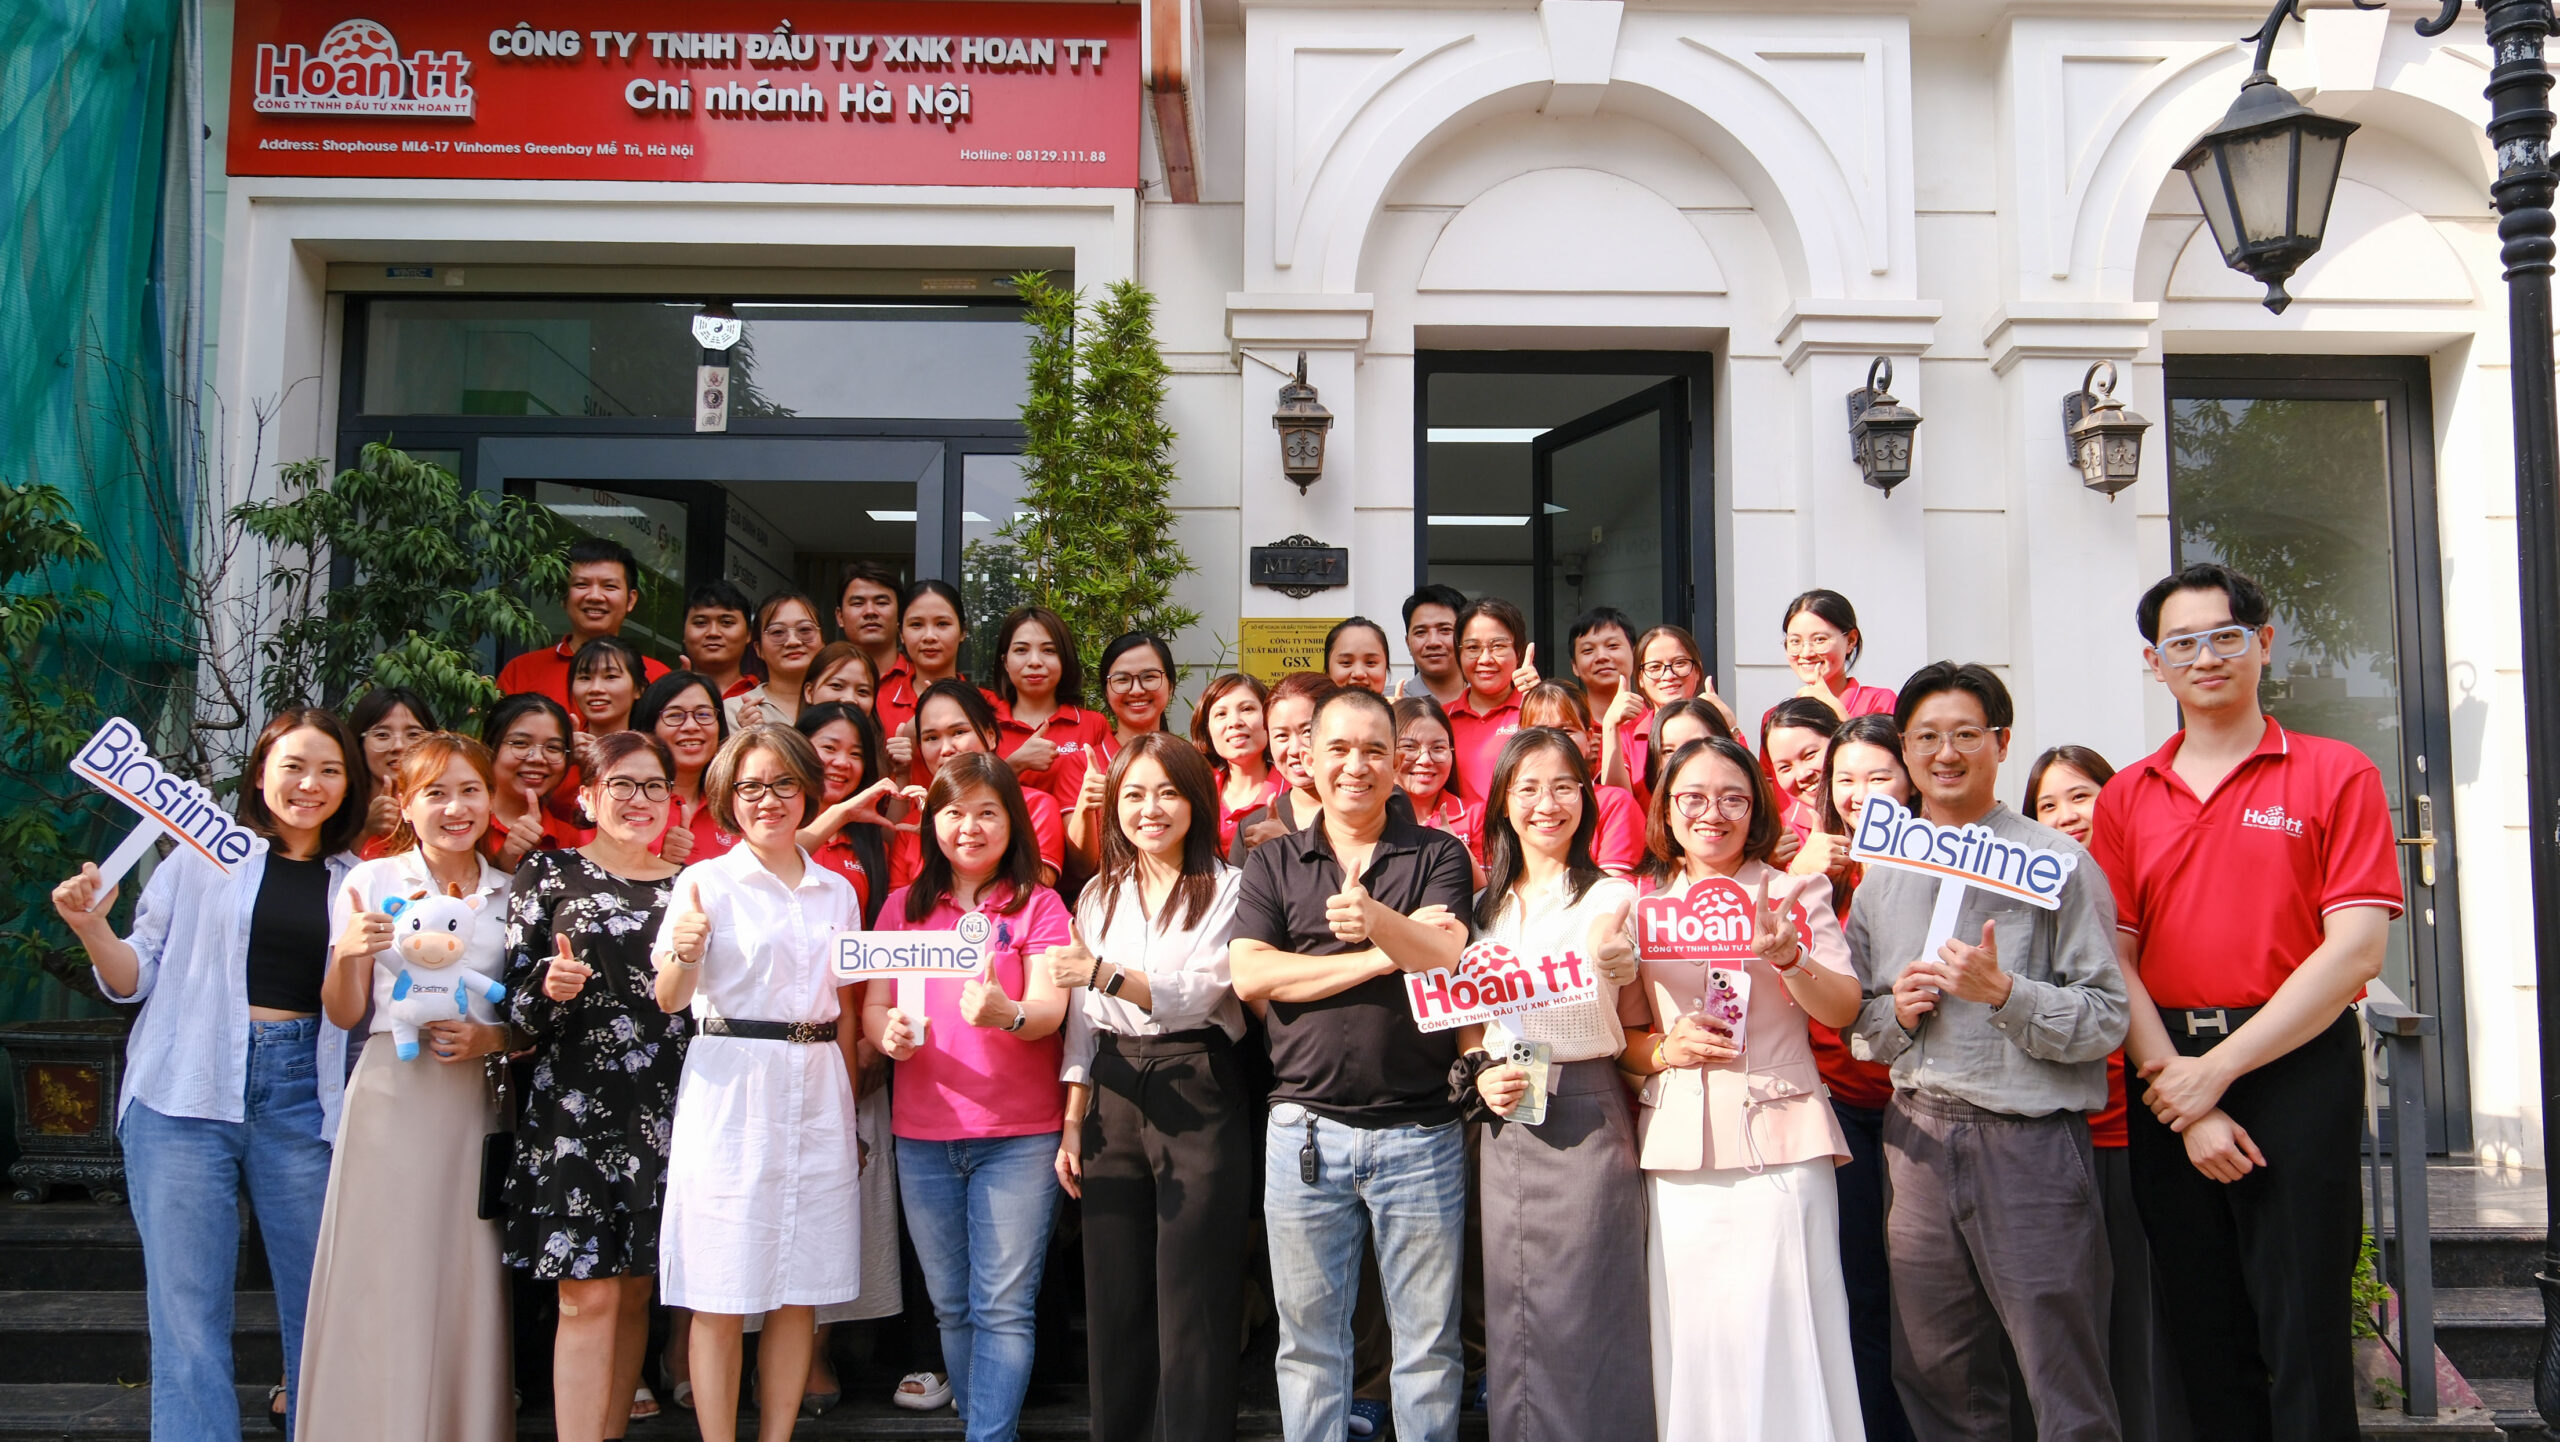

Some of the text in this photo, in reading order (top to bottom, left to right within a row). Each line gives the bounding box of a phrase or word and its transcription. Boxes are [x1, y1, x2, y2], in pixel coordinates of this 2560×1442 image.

[488, 18, 1107, 66] CÔNG TY TNHH ĐẦU TƯ XNK HOAN TT
[257, 100, 290, 110] CÔNG
[293, 101, 308, 110] TY
[310, 101, 341, 110] TNHH
[372, 102, 387, 111] TƯ
[390, 102, 414, 112] XNK
[417, 103, 451, 112] HOAN
[455, 104, 468, 113] TT
[624, 78, 970, 124] Chi nhánh Hà Nội
[259, 139, 319, 150] Address:
[322, 139, 398, 153] Shophouse
[402, 141, 450, 152] ML6-17
[454, 142, 521, 154] Vinhomes
[524, 142, 593, 157] Greenbay
[647, 143, 667, 156] Hà
[671, 144, 694, 160] Nội
[960, 149, 1106, 162] Hotline: 08129.111.88
[1282, 656, 1311, 668] GSX
[81, 722, 252, 864] Biostime
[2243, 807, 2286, 827] Hoan
[1858, 797, 2062, 894] Biostime
[1646, 906, 1752, 943] Hoan
[839, 938, 979, 971] Biostime
[1647, 944, 1672, 953] CÔNG
[1686, 945, 1710, 953] TNHH
[1731, 944, 1744, 952] TƯ
[1411, 968, 1536, 1019] Hoan
[1421, 991, 1596, 1031] CÔNG TY TNHH ĐẦU TƯ XNK HOAN TT
